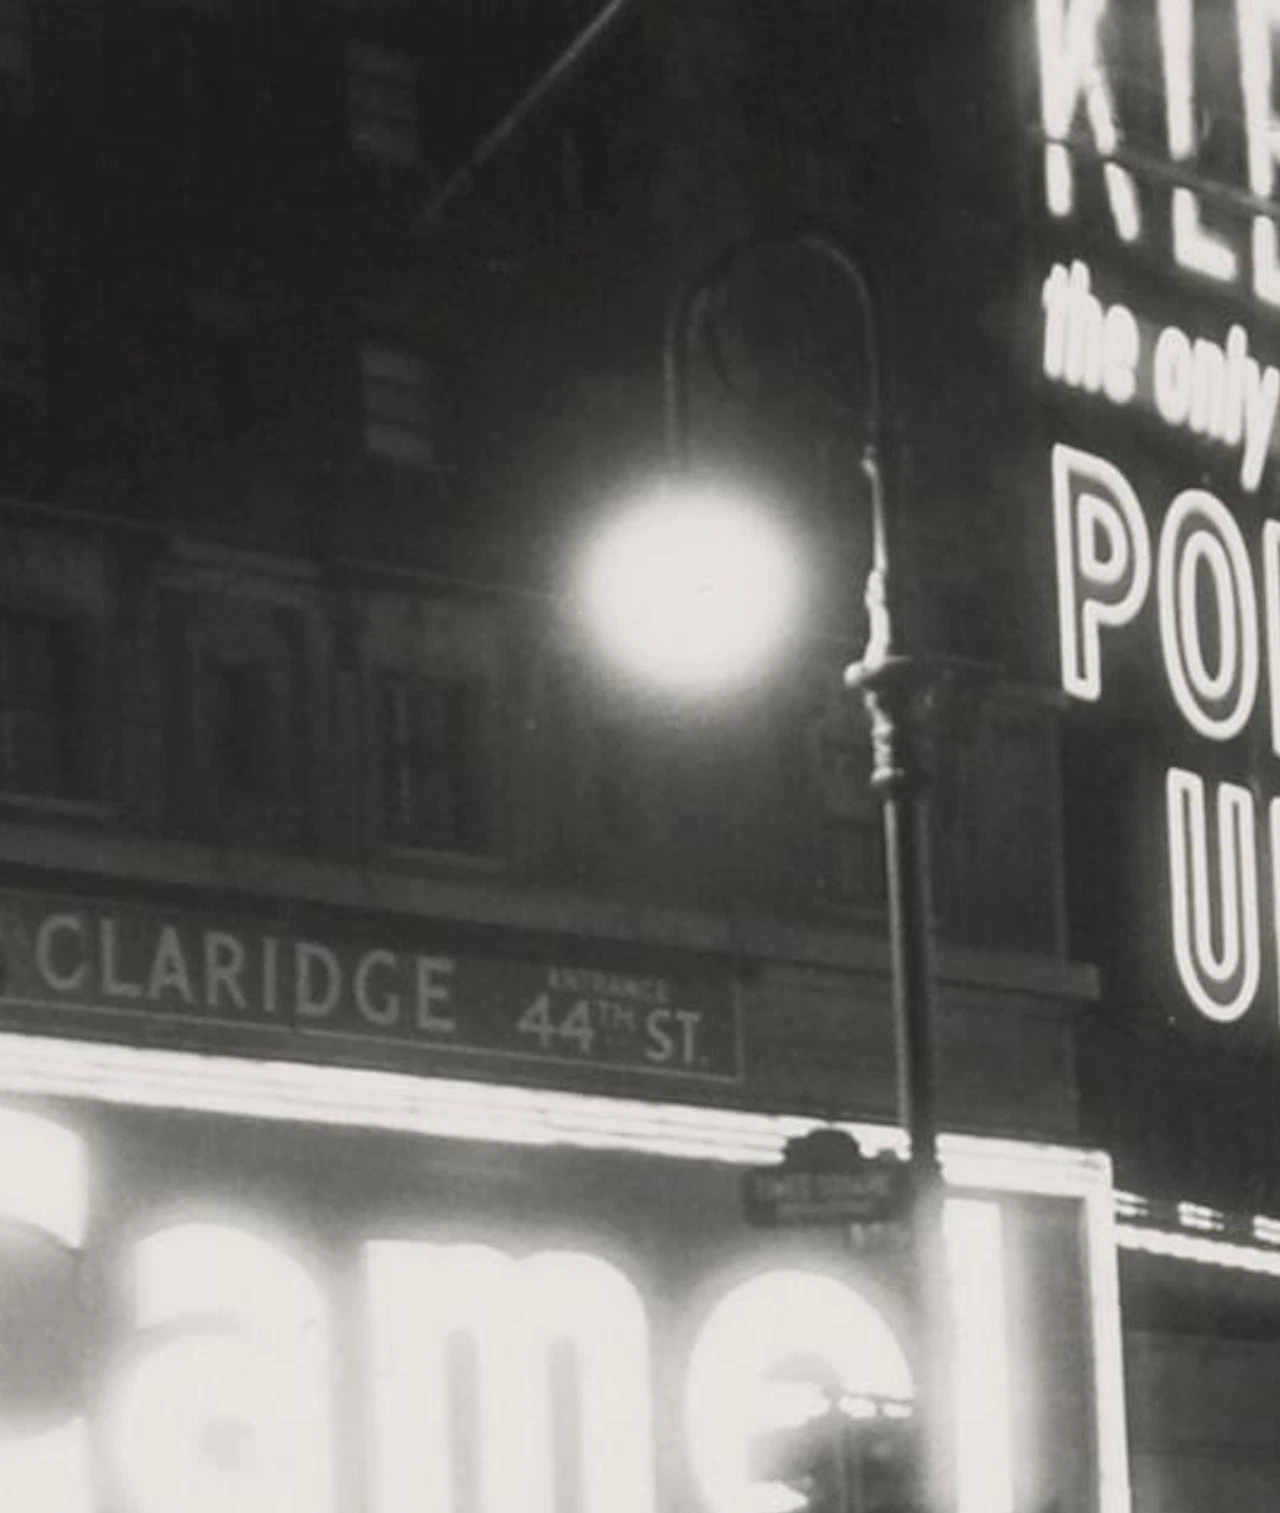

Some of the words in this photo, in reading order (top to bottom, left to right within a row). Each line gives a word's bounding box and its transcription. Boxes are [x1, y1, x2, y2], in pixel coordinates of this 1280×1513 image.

[1042, 260, 1140, 403] the
[1154, 324, 1280, 492] only
[35, 913, 458, 1034] CLARIDGE
